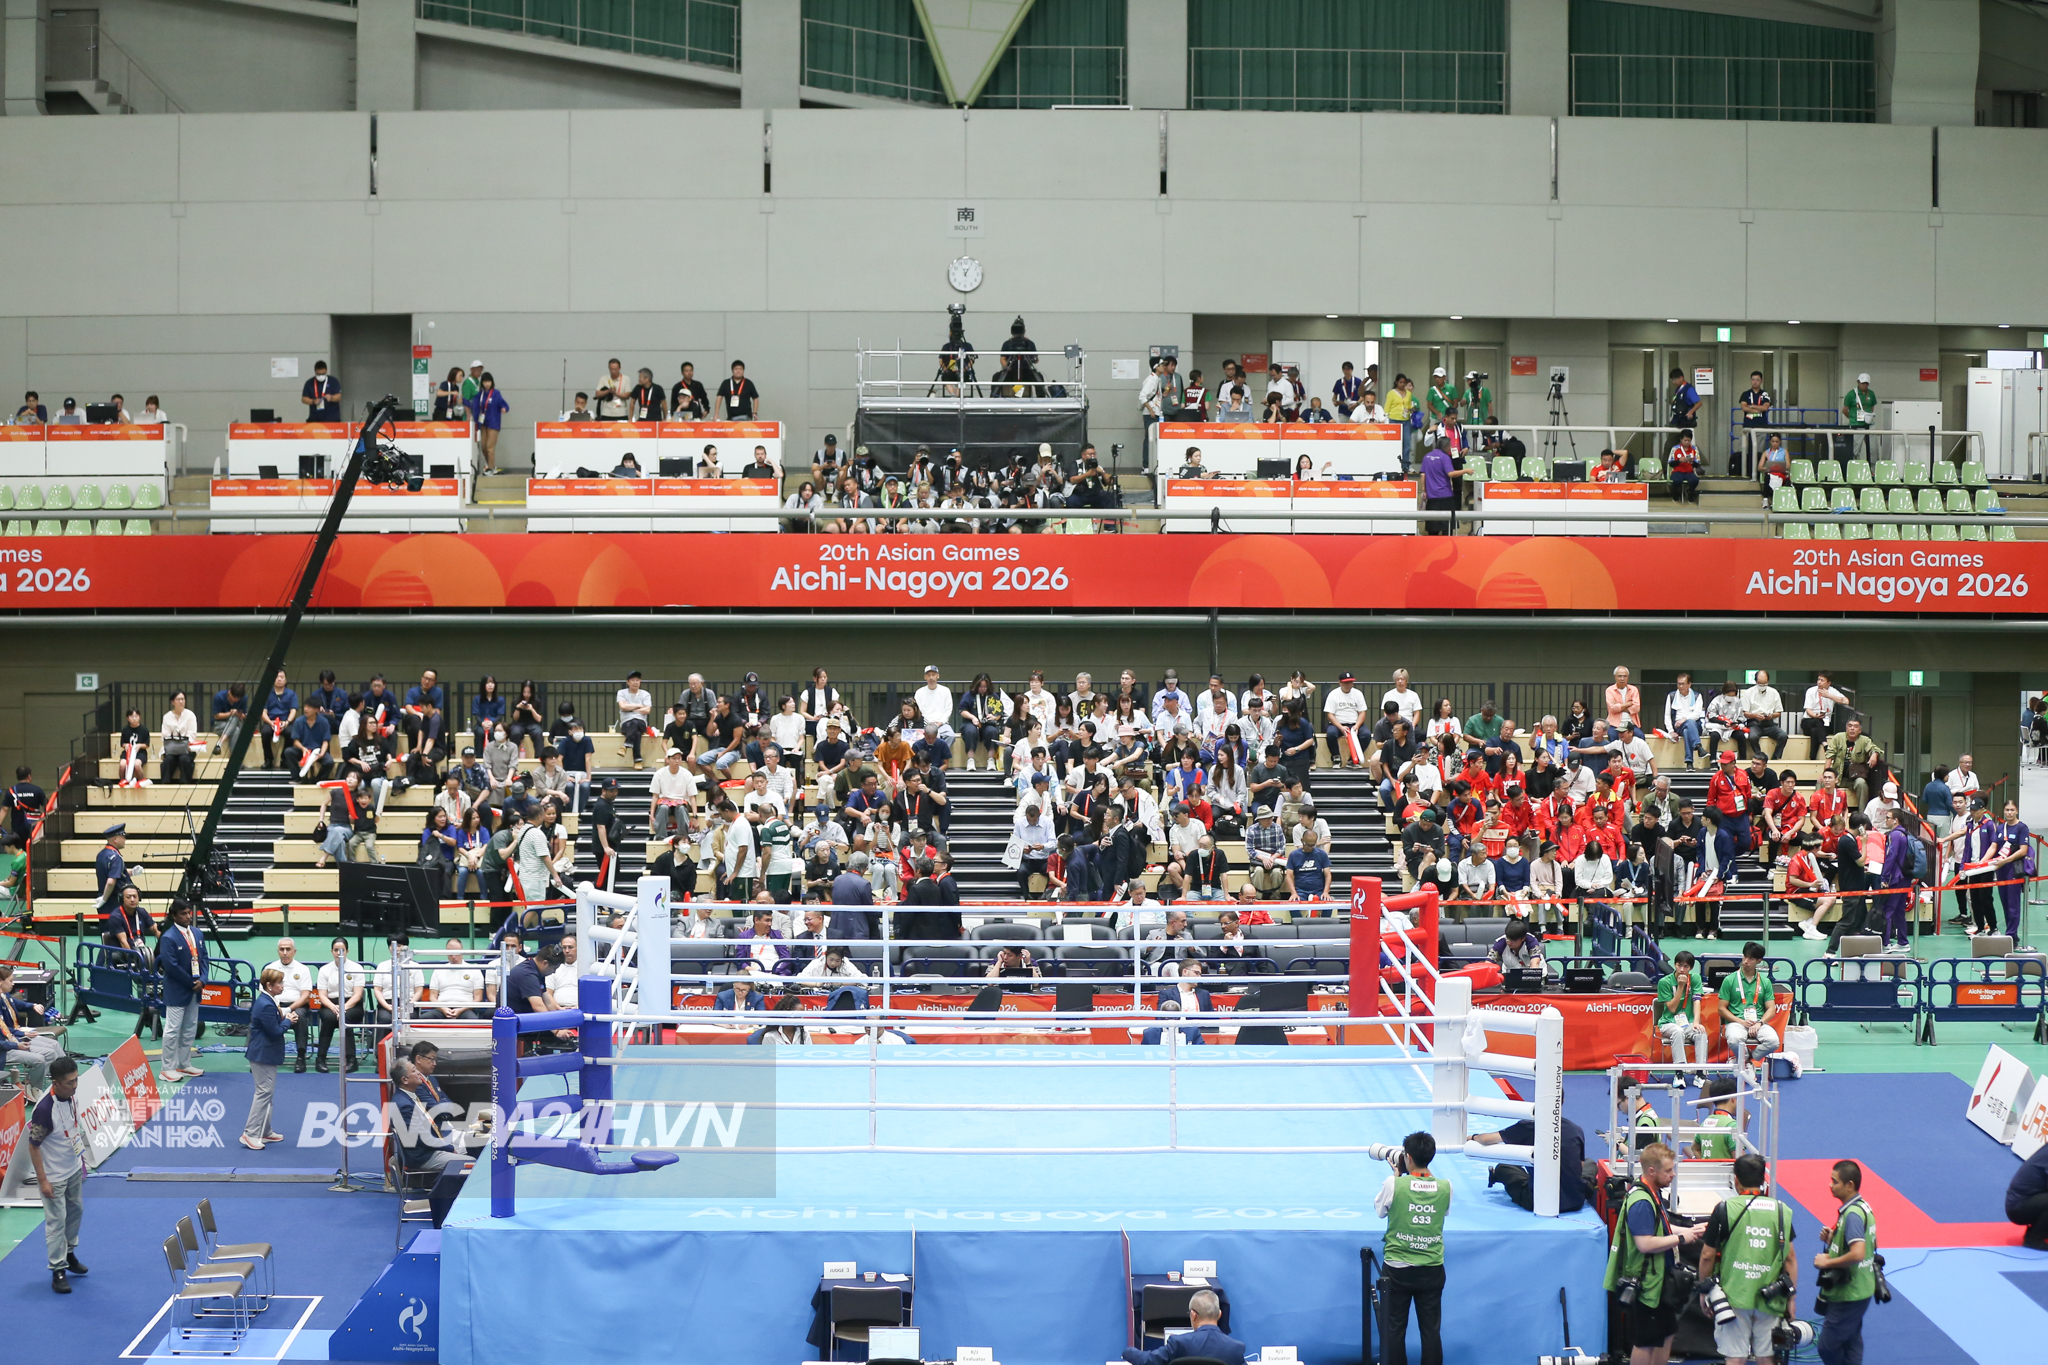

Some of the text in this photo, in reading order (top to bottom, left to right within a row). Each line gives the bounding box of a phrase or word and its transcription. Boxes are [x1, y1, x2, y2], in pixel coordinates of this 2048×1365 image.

[957, 207, 975, 221] 南
[0, 549, 43, 563] mes
[819, 543, 1020, 561] 20th Asian Games
[1793, 548, 1984, 567] 20th Asian Games
[17, 568, 90, 592] 2026
[770, 564, 1069, 598] Aichi-Nagoya 2026
[1745, 569, 2029, 603] Aichi-Nagoya 2026
[916, 1003, 969, 1012] Aichi-Nag
[1586, 1003, 1654, 1014] Aichi-Nagoy
[1553, 1066, 1562, 1133] Aichi-Nagoya
[81, 1094, 117, 1134] TOYOTA
[687, 1207, 1362, 1222] Aichi-Nagoya 2026
[1408, 1204, 1436, 1213] POOL
[1412, 1215, 1431, 1224] 633
[1746, 1226, 1772, 1238] POOL
[1749, 1239, 1766, 1248] 180
[1733, 1261, 1771, 1272] Aichi-Nago
